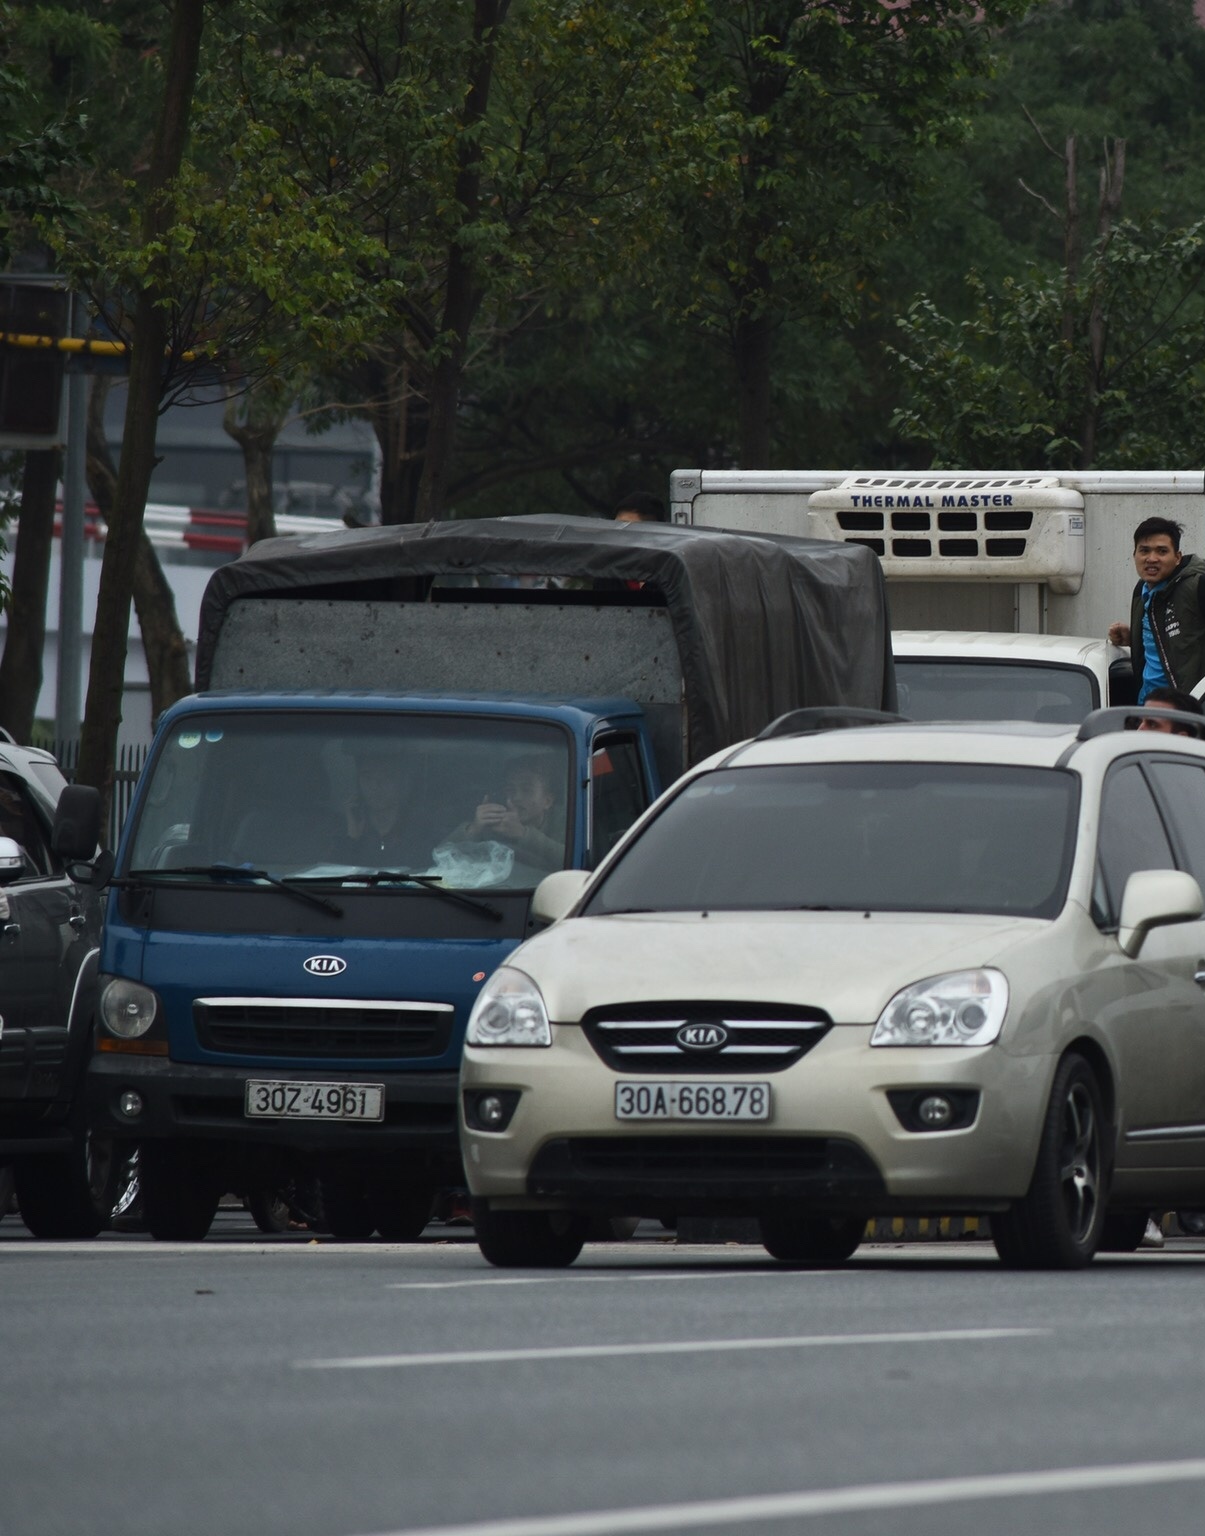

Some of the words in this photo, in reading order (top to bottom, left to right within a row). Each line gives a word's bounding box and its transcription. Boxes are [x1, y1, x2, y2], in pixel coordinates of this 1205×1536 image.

[850, 495, 934, 508] THERMAL
[941, 494, 1014, 507] MASTER
[310, 959, 340, 972] KIA
[685, 1029, 719, 1043] KIA
[620, 1086, 765, 1116] 30A-668.78
